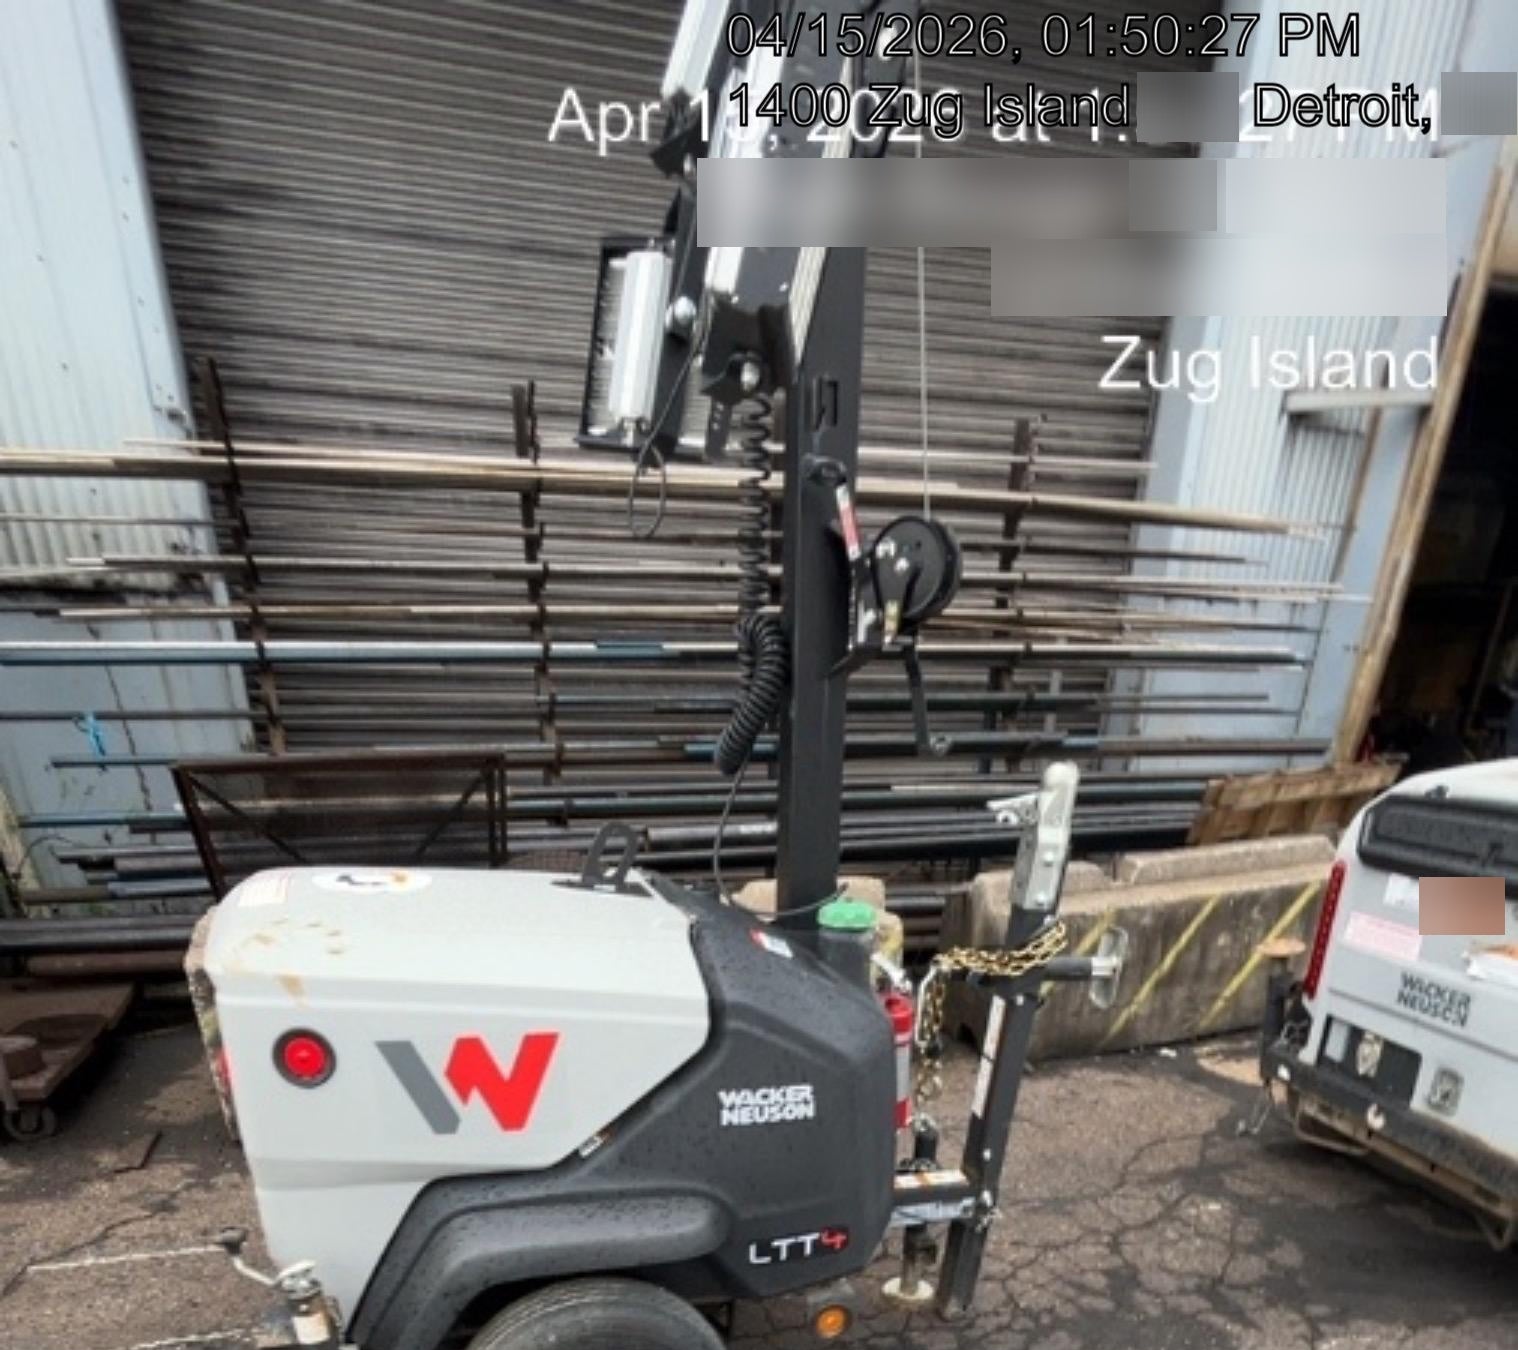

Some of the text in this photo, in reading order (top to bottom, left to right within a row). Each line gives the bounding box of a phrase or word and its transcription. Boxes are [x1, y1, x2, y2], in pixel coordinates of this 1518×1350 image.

[718, 1085, 814, 1107] WACKER
[721, 1102, 816, 1126] NEUSON
[749, 1227, 847, 1264] LTT4
